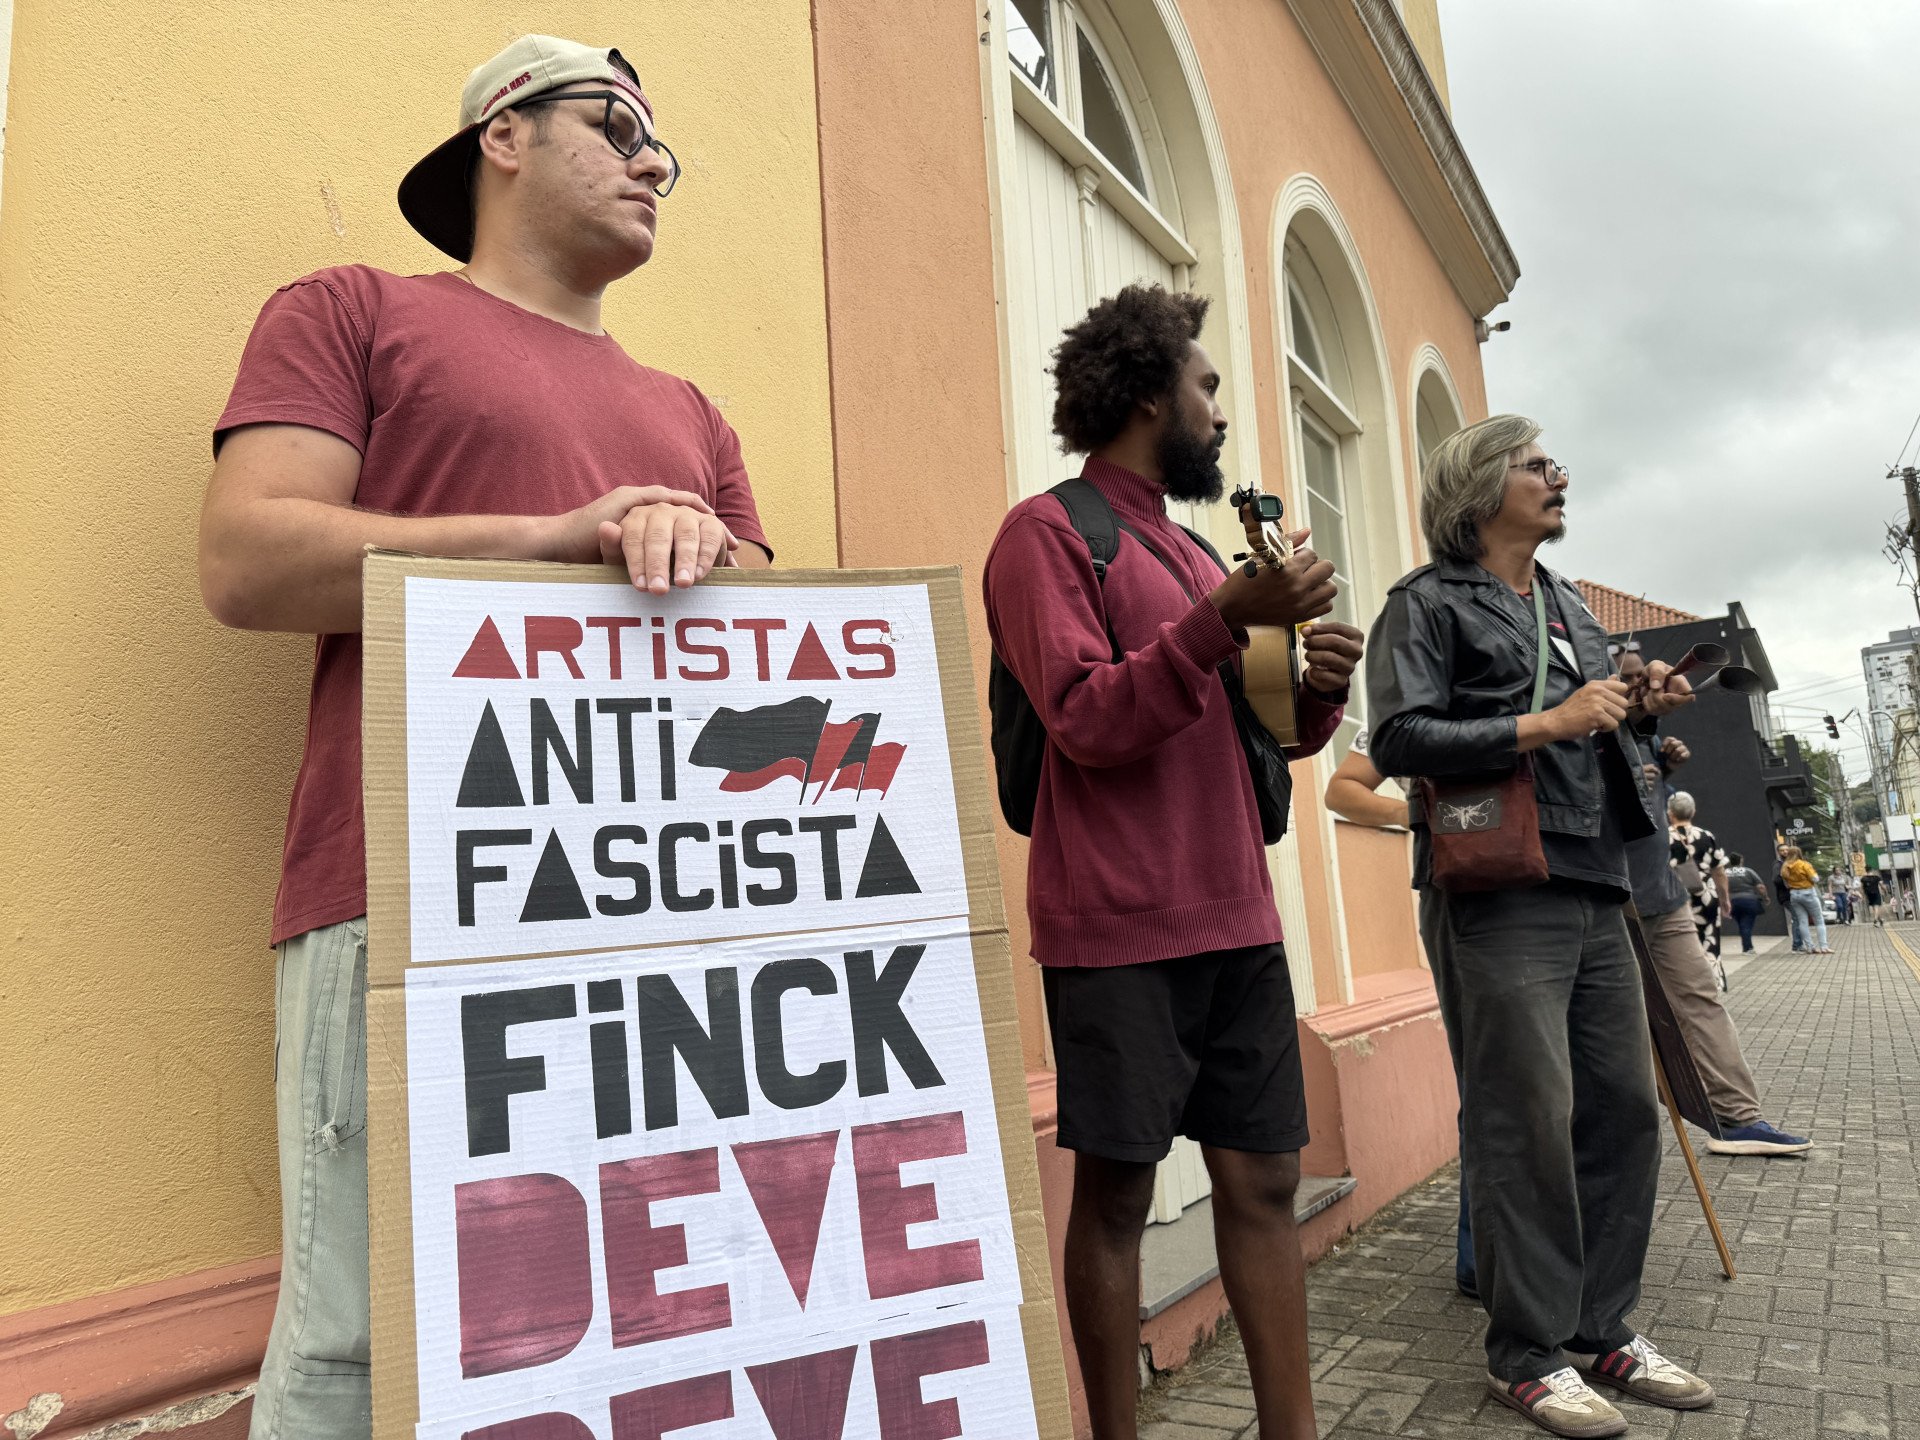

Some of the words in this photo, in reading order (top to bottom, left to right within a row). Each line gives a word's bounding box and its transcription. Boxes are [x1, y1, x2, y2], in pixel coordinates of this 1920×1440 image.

[509, 71, 532, 91] HATS
[454, 1111, 986, 1380] DEVE
[460, 1320, 991, 1440] VE
